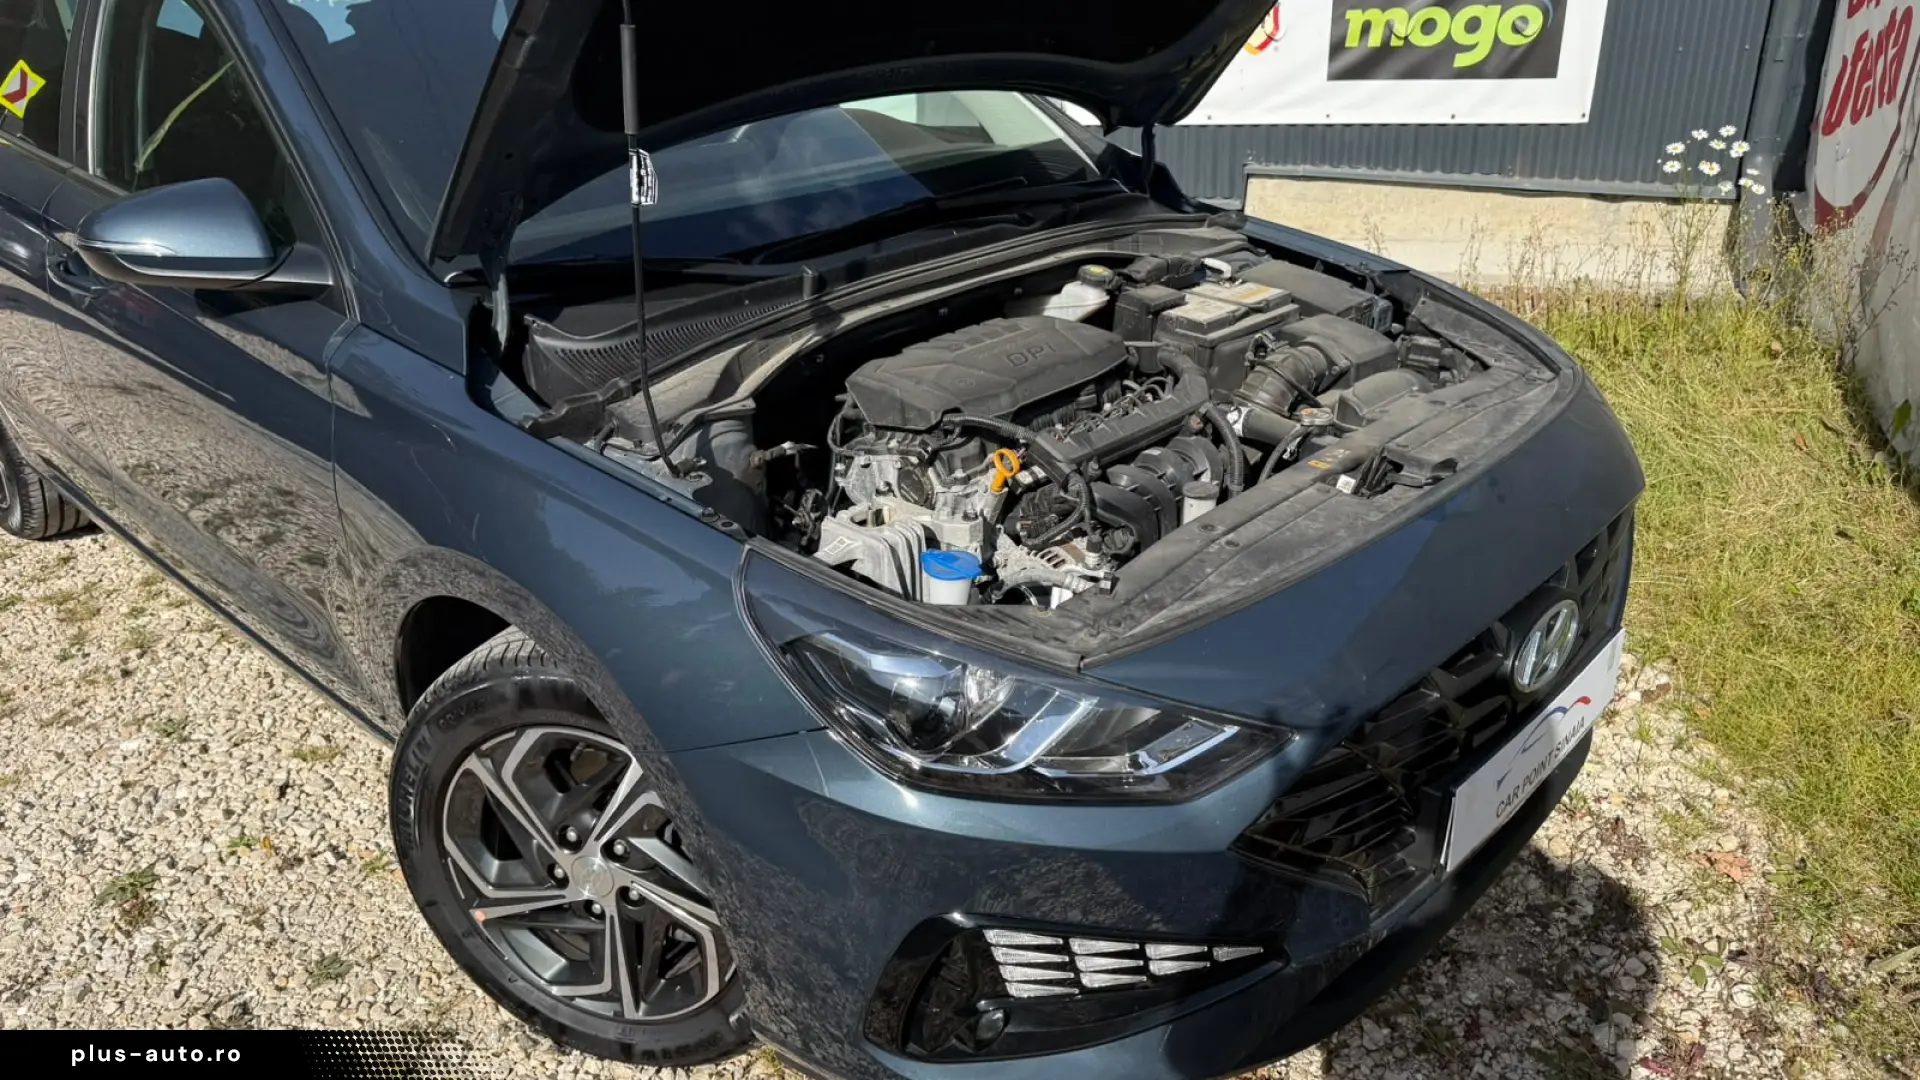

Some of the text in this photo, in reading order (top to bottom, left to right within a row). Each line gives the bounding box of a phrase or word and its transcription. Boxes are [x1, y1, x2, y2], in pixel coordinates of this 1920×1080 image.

[1344, 4, 1544, 68] mogo
[1006, 342, 1056, 368] DPI
[1496, 784, 1521, 819] CAR
[1521, 748, 1555, 794] POINT
